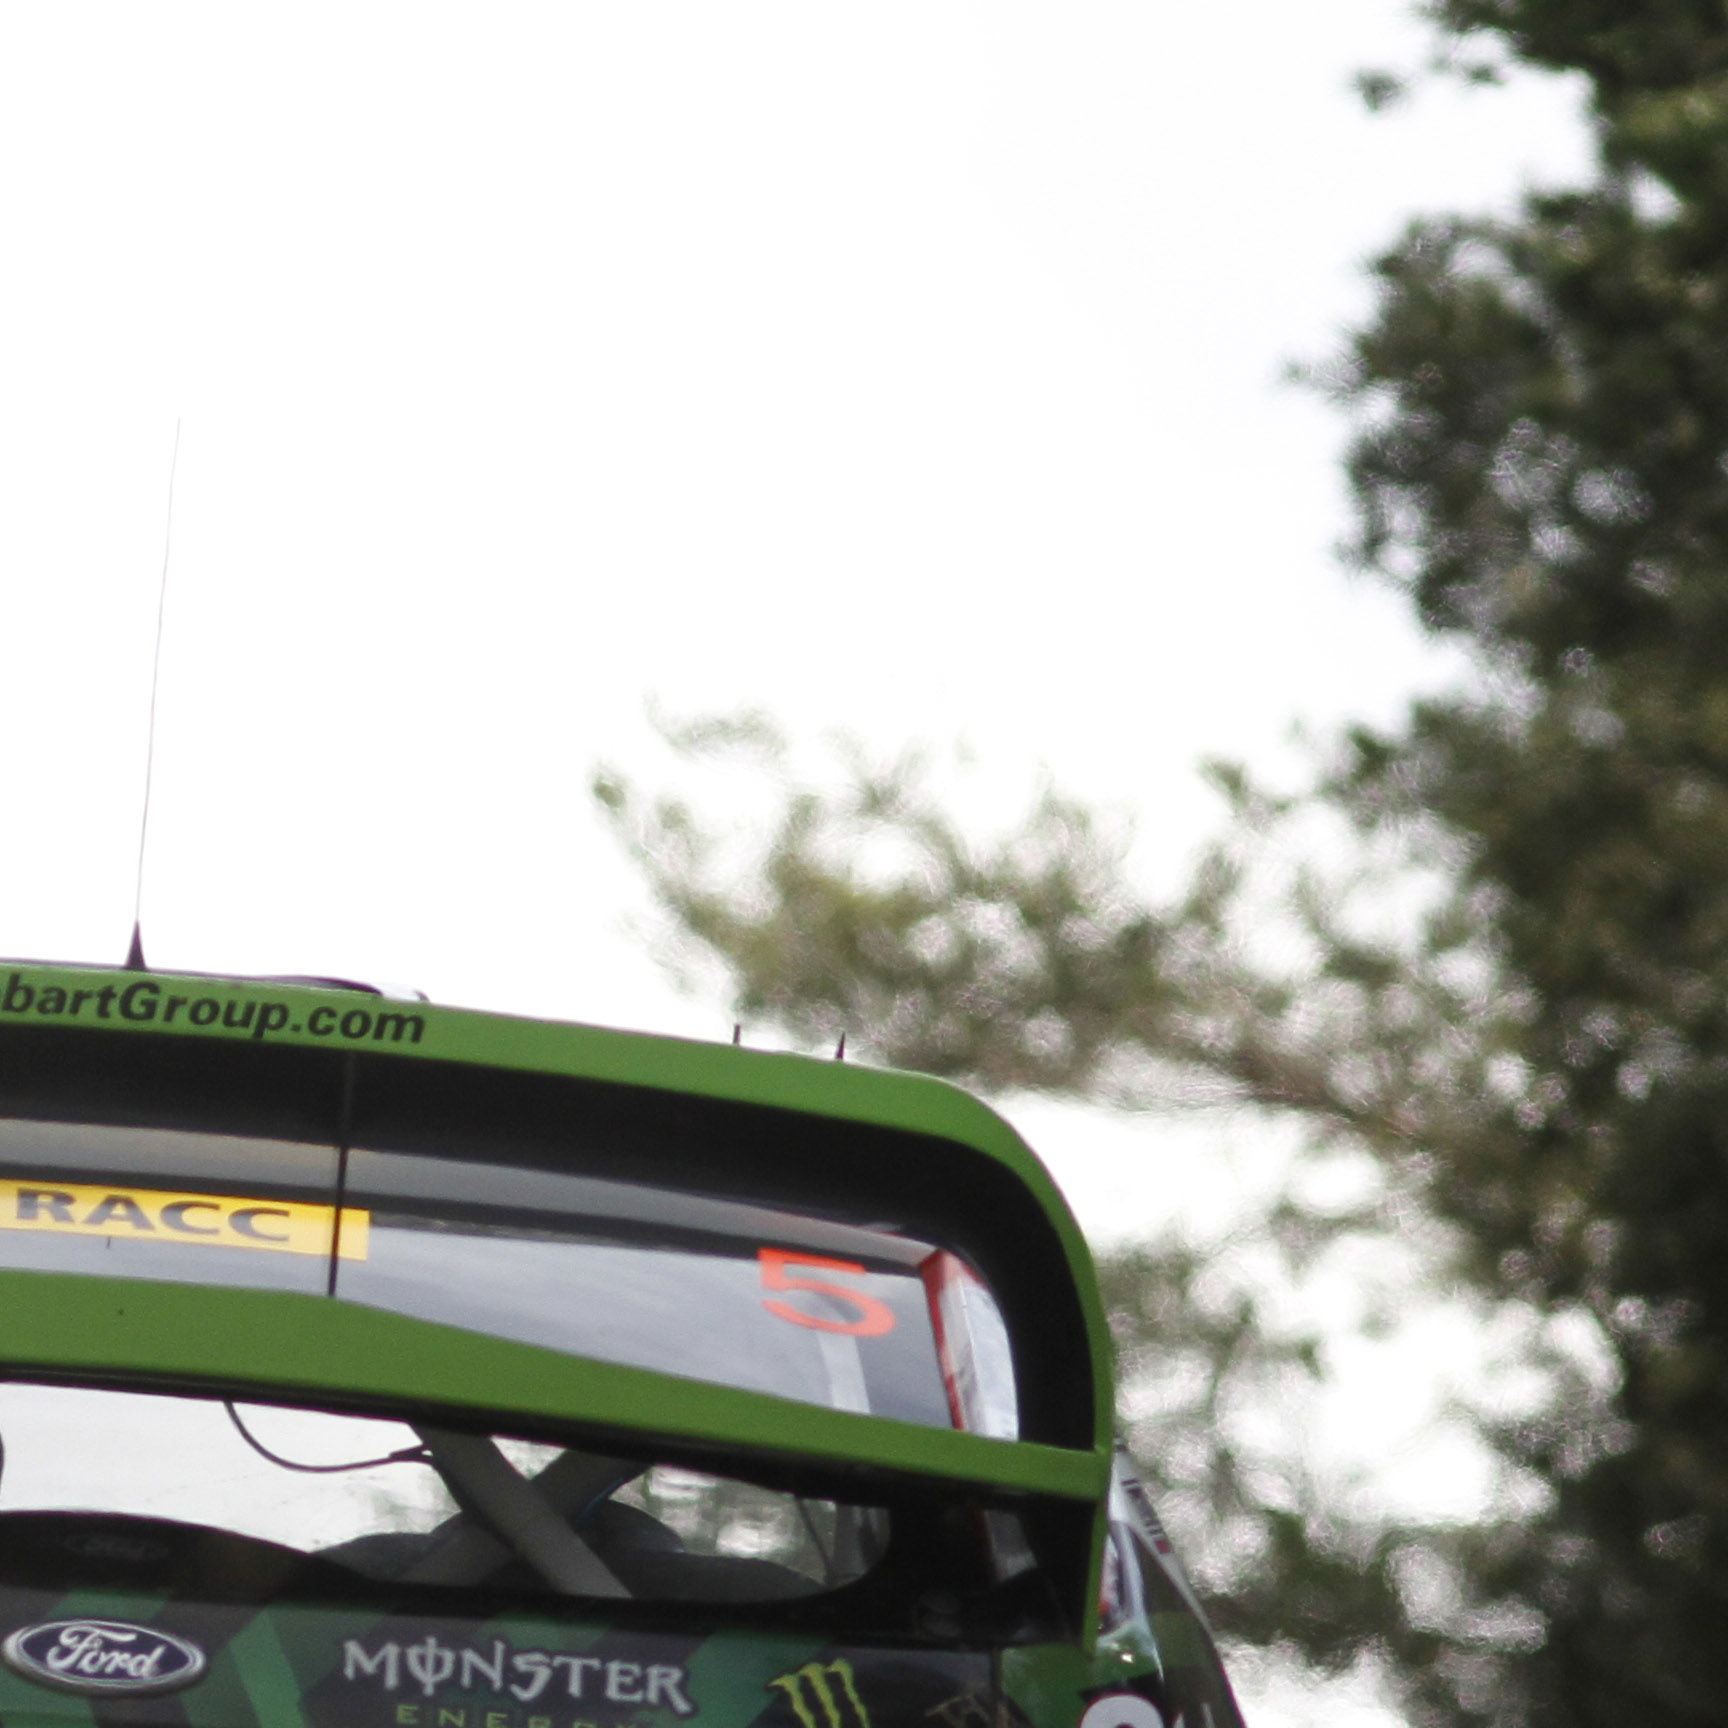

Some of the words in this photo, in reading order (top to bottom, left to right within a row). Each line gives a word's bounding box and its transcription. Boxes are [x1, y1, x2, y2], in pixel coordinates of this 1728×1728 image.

[16, 1188, 290, 1241] RACC
[757, 1247, 896, 1337] 5
[44, 1625, 164, 1678] Ford
[343, 1636, 693, 1713] MONSTER
